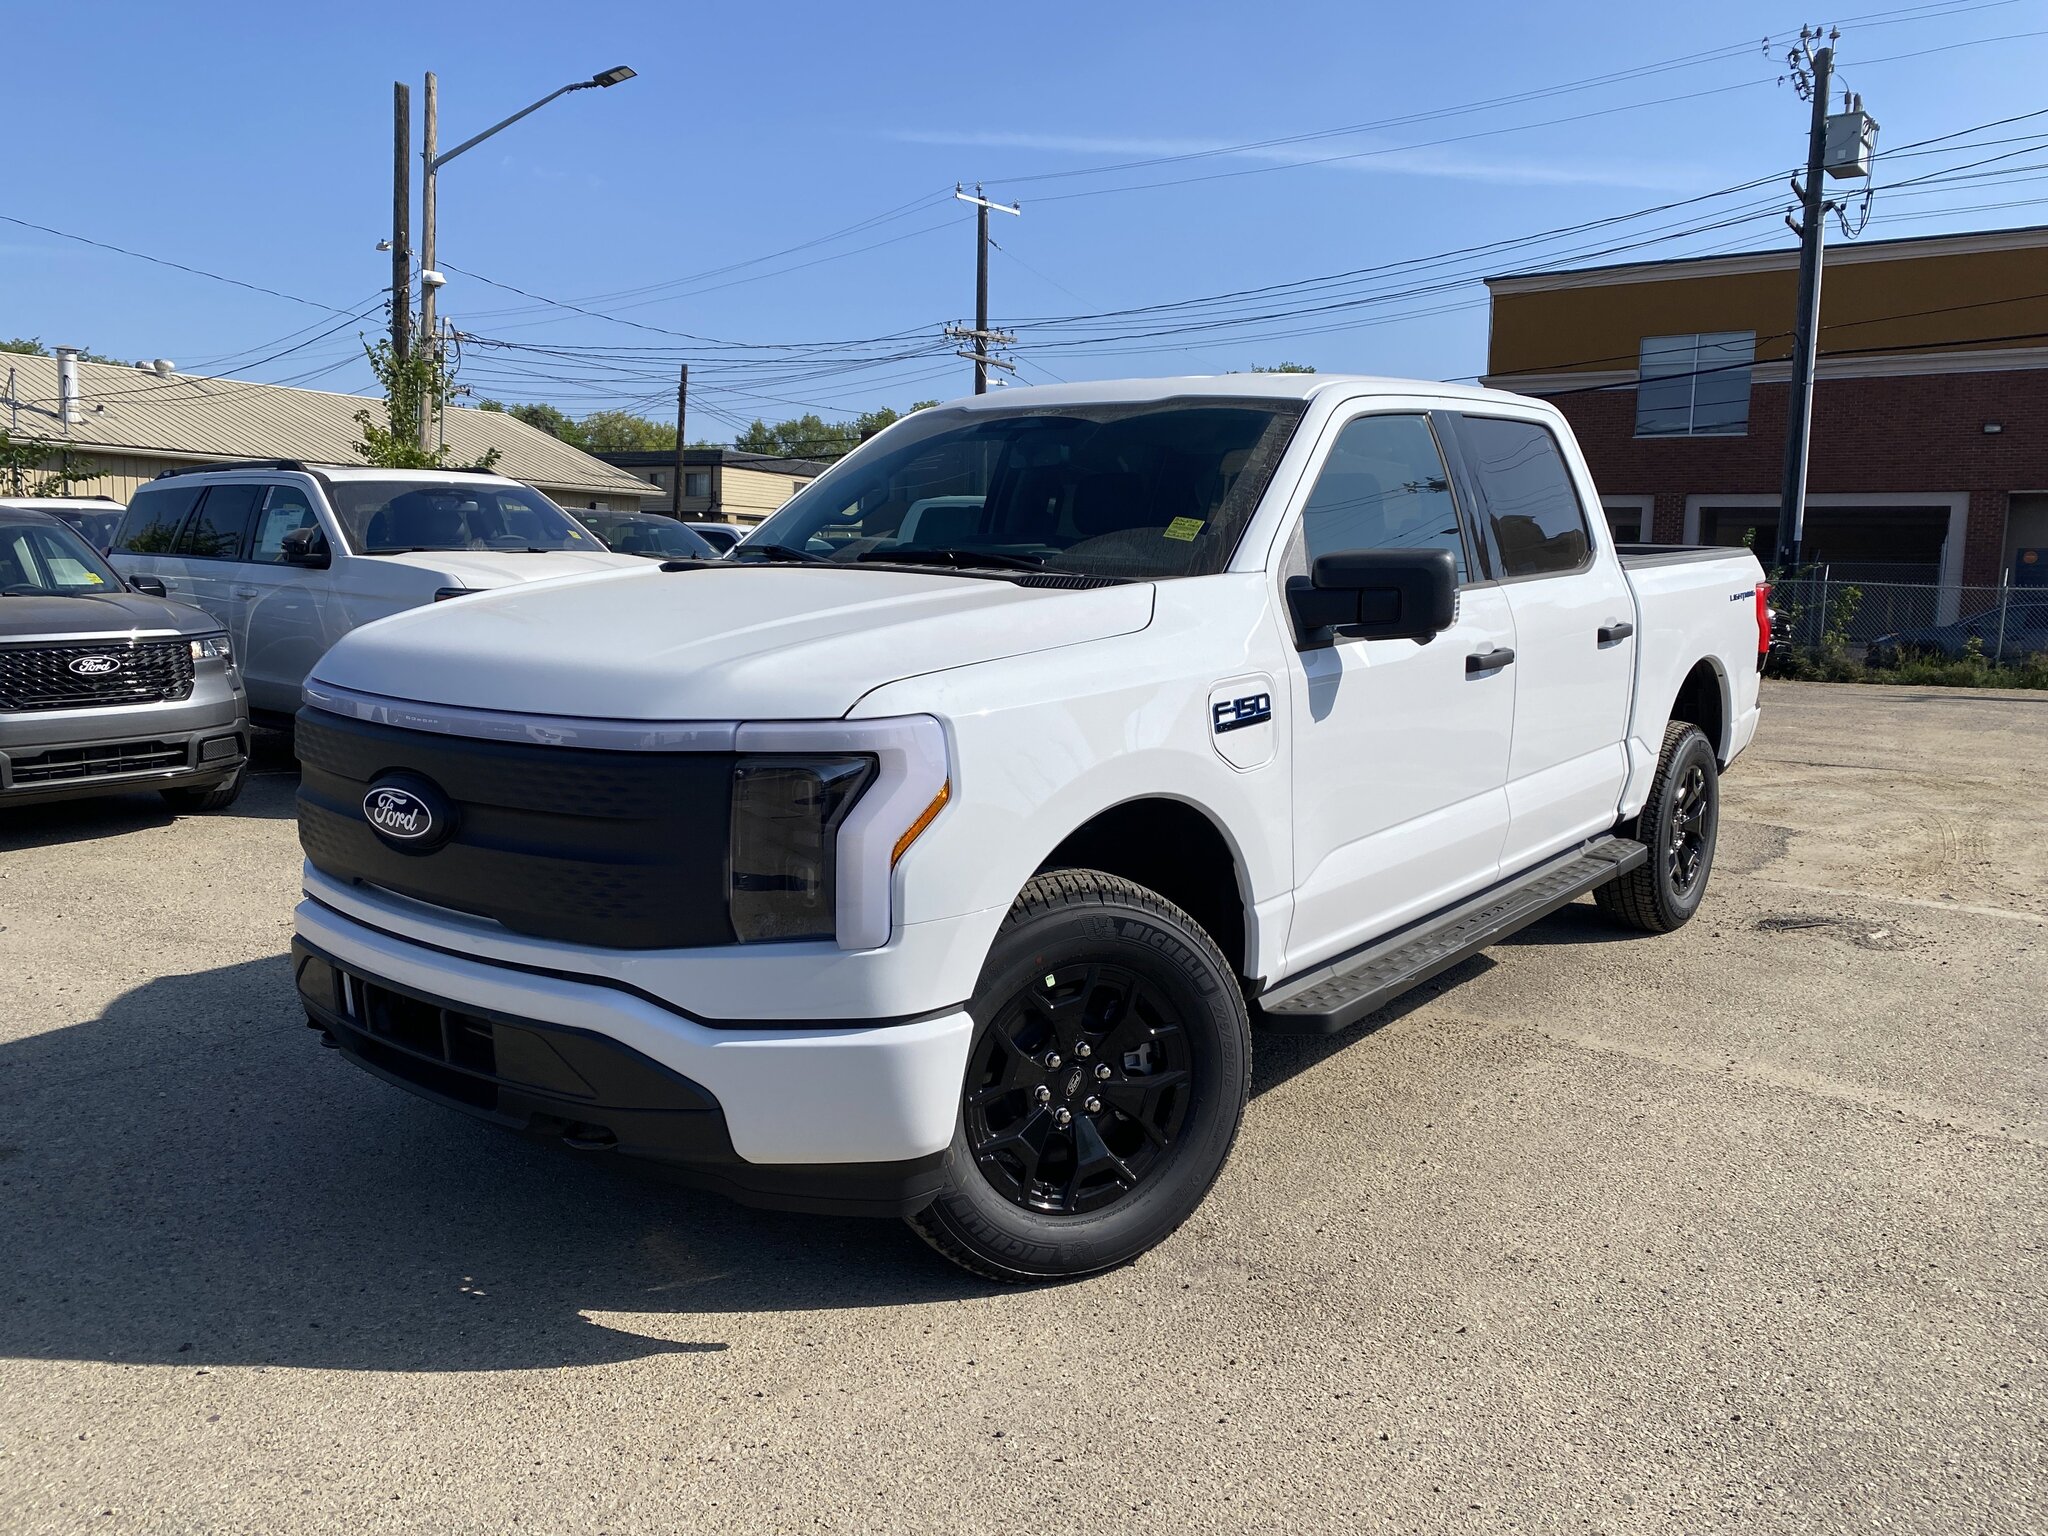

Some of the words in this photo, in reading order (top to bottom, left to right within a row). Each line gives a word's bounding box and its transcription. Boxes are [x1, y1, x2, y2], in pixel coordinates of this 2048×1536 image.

[1729, 590, 1756, 601] LIGHT
[79, 659, 111, 671] Ford
[1212, 692, 1271, 724] F-150
[374, 793, 418, 831] Ford
[1120, 921, 1217, 995] MICHELIN
[949, 1199, 1060, 1265] MICHELIN
